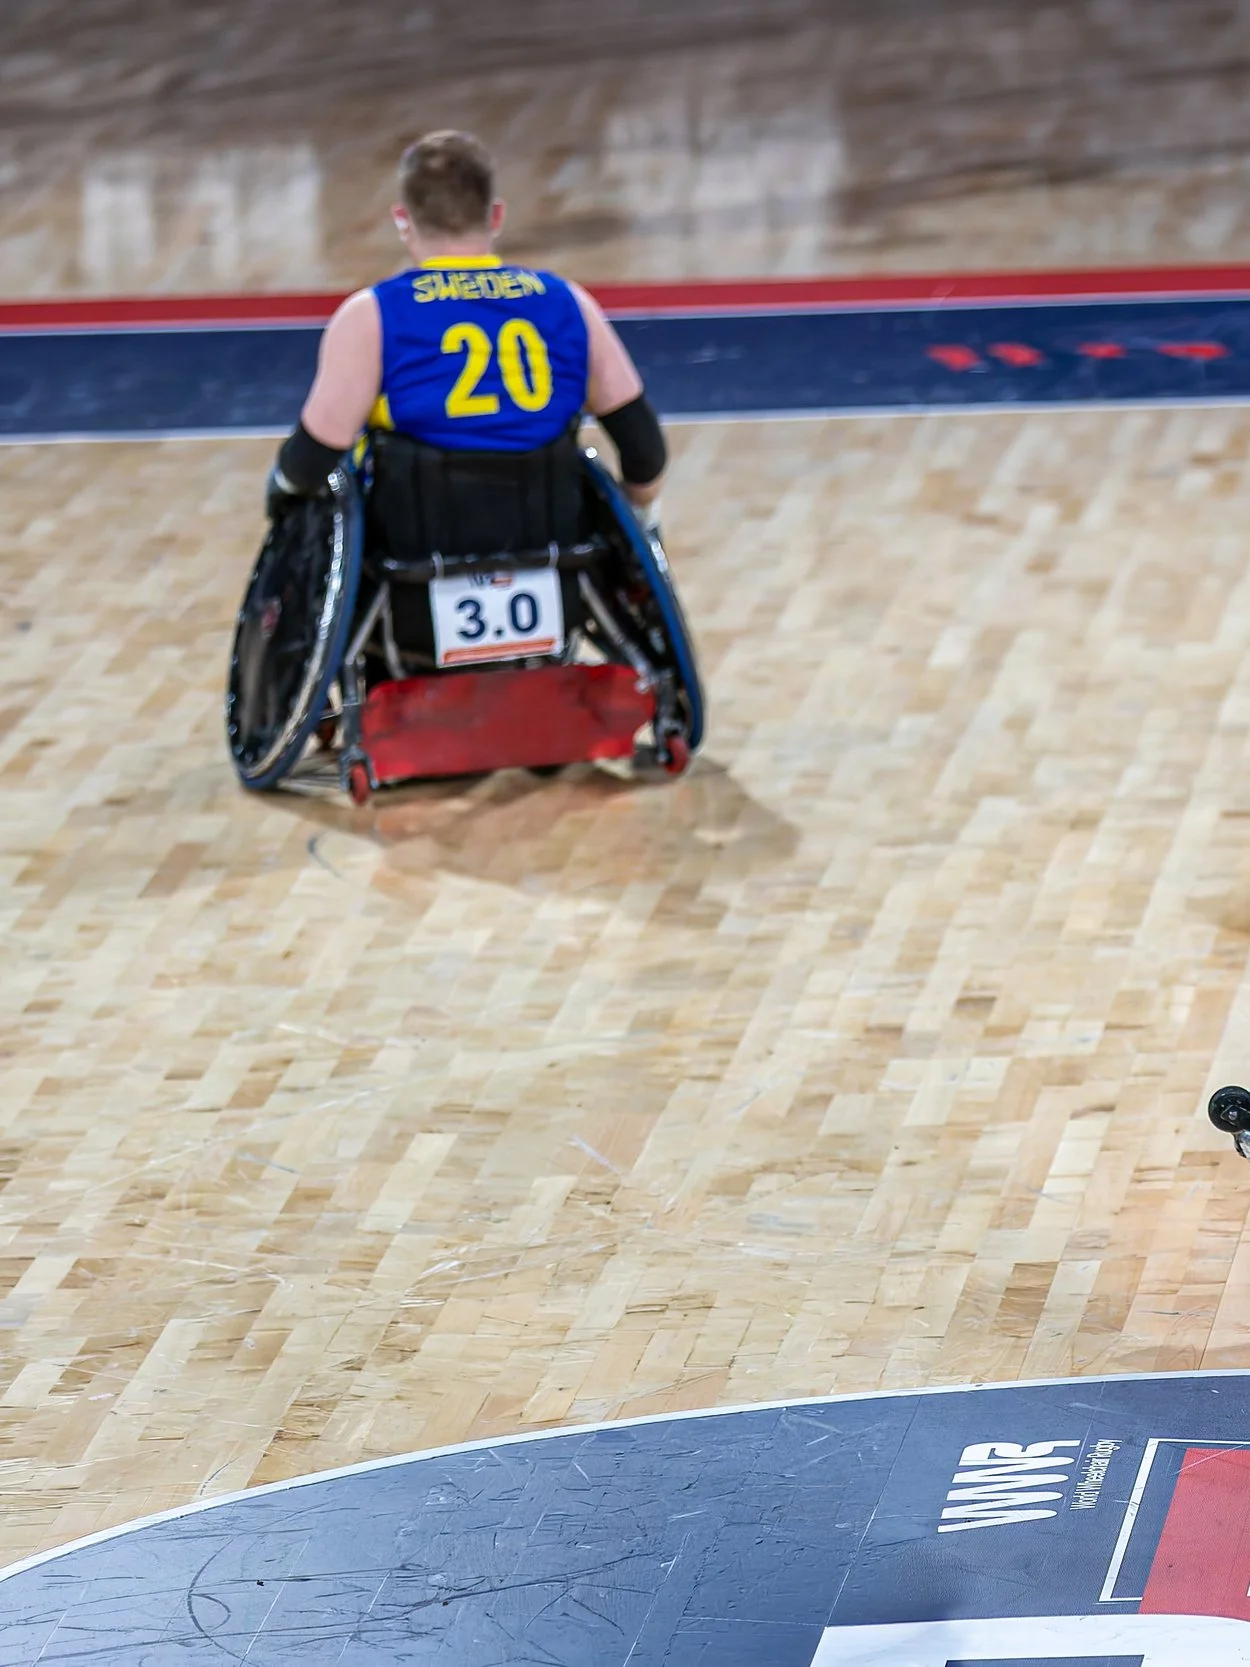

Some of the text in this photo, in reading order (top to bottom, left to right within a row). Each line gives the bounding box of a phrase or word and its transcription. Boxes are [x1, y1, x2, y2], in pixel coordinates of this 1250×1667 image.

[412, 271, 546, 303] SWEDEN
[440, 318, 553, 419] 20
[456, 593, 538, 638] 3.0
[937, 1439, 1081, 1533] WWR
[1069, 1439, 1122, 1511] World Wheelchair Rugby
